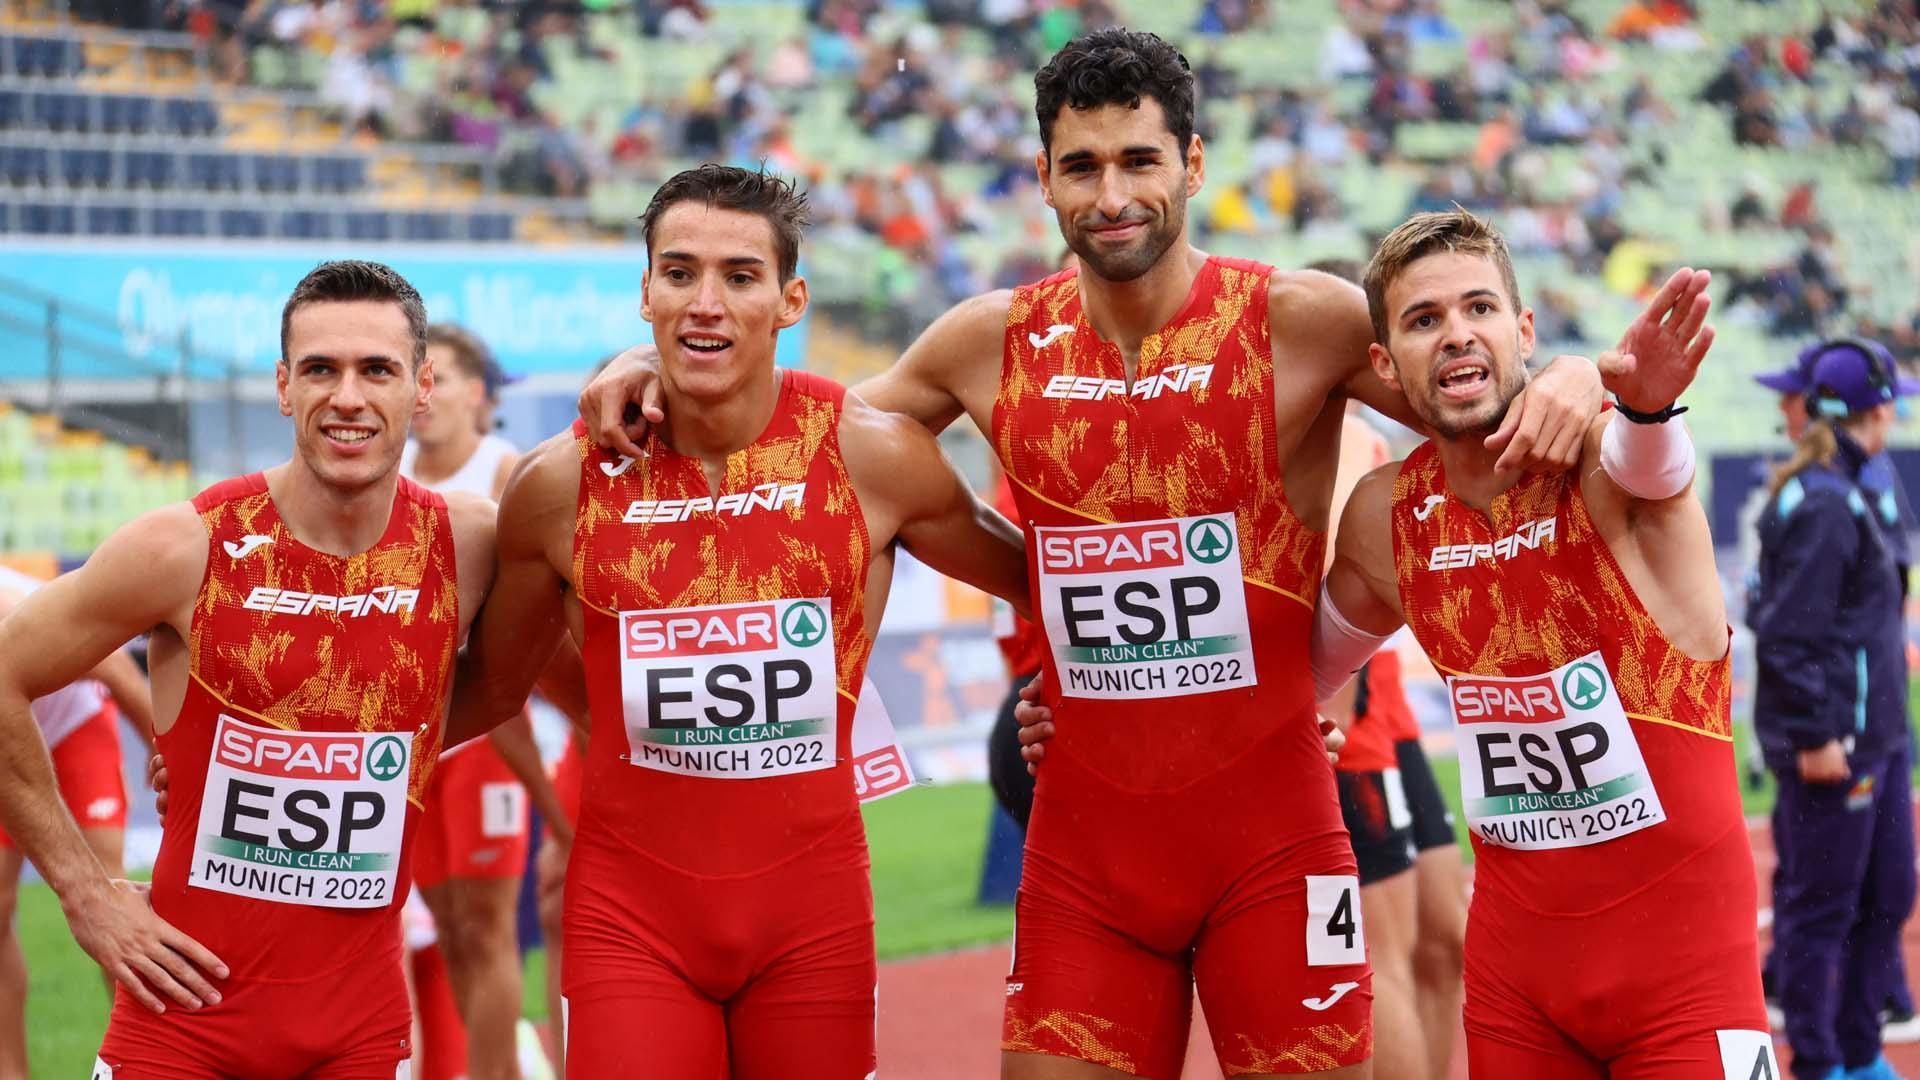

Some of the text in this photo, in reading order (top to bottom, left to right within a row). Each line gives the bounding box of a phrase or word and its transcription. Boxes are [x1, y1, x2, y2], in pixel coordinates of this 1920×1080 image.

[1042, 363, 1215, 401] ESPAÑA
[622, 482, 808, 524] ESPAÑA
[1043, 529, 1181, 569] SPAR
[1428, 517, 1557, 572] ESPAÑA
[243, 586, 420, 618] ESPAÑA
[1060, 575, 1222, 648] ESP
[628, 611, 775, 652] SPAR
[1092, 648, 1098, 662] I
[1101, 647, 1137, 662] RUN
[646, 659, 813, 730] ESP
[1068, 659, 1243, 692] MUNICH 2022
[1454, 684, 1560, 719] SPAR
[219, 729, 358, 775] SPAR
[643, 741, 824, 771] MUNICH 2022
[675, 730, 680, 744] I
[686, 729, 723, 744] RUN
[1476, 721, 1611, 798] ESP
[219, 778, 386, 853] ESP
[1480, 798, 1650, 844] MUNICH 2022
[1508, 798, 1515, 812] I
[1519, 794, 1550, 811] RUN
[243, 845, 249, 858] I
[254, 847, 293, 865] RUN
[205, 859, 387, 900] MUNICH 2022
[1326, 888, 1356, 949] 4
